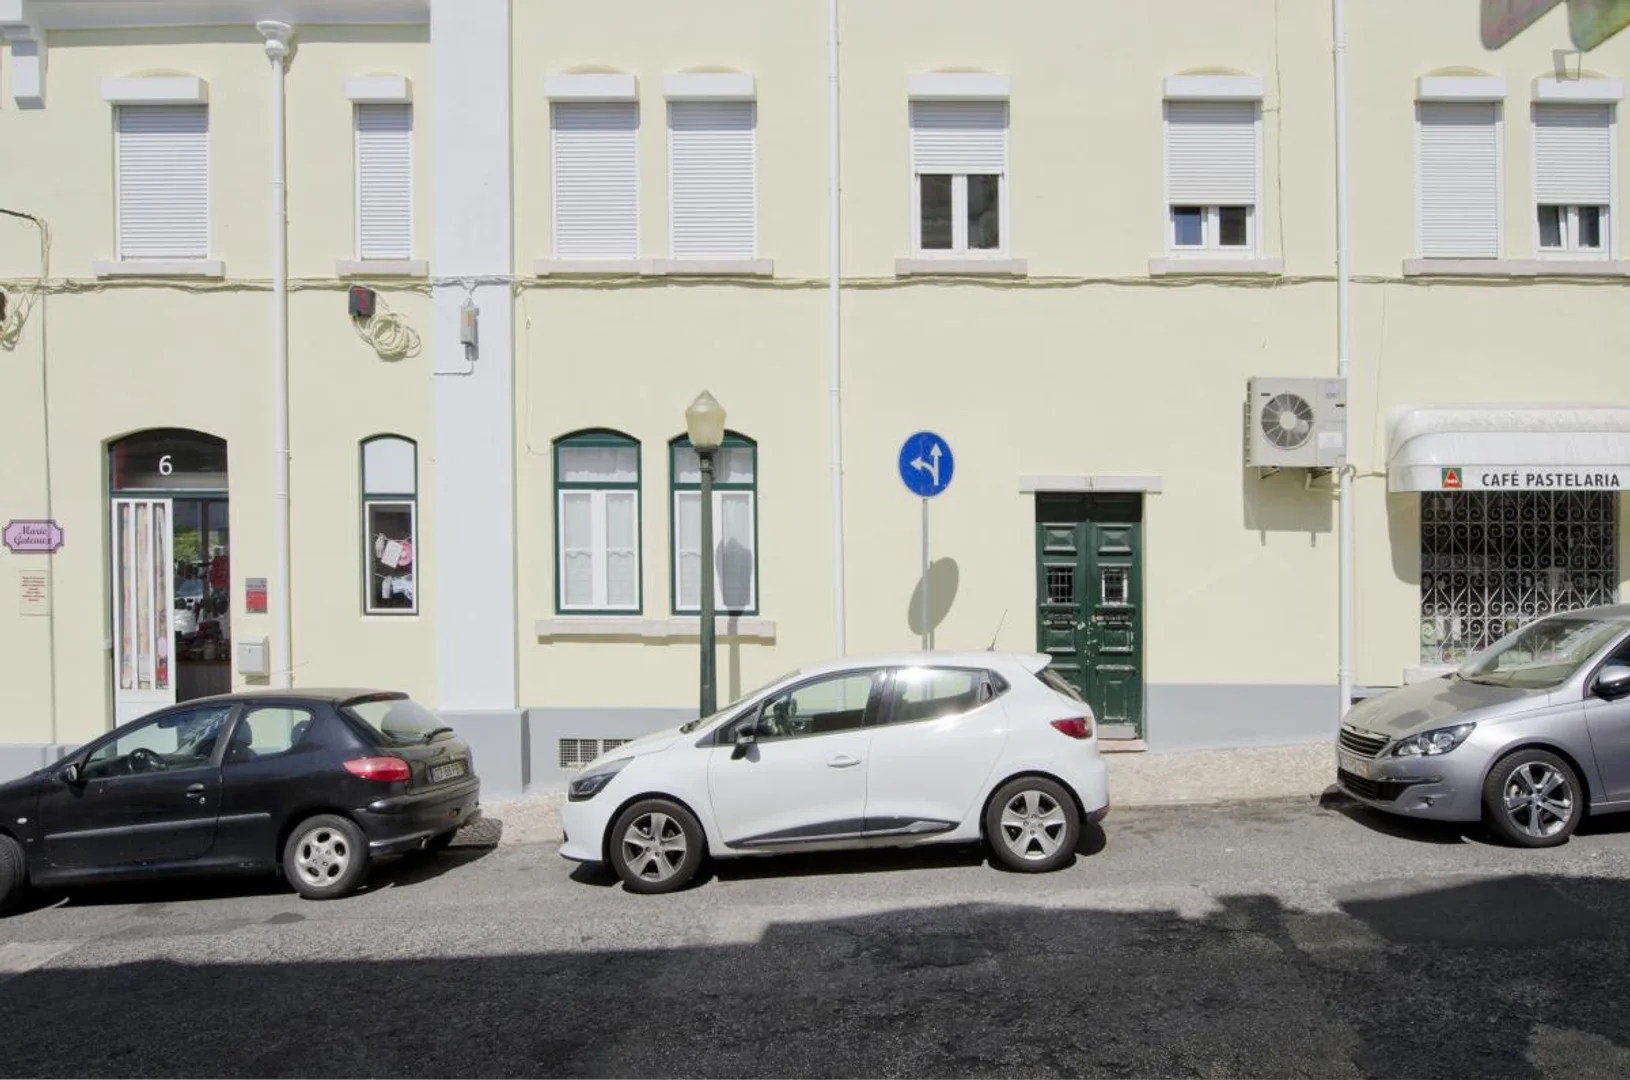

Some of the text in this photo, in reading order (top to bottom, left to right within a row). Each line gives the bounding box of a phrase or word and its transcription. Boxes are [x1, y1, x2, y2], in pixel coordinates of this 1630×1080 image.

[159, 455, 172, 475] 6
[1482, 470, 1620, 487] CAFÉ PASTELARIA
